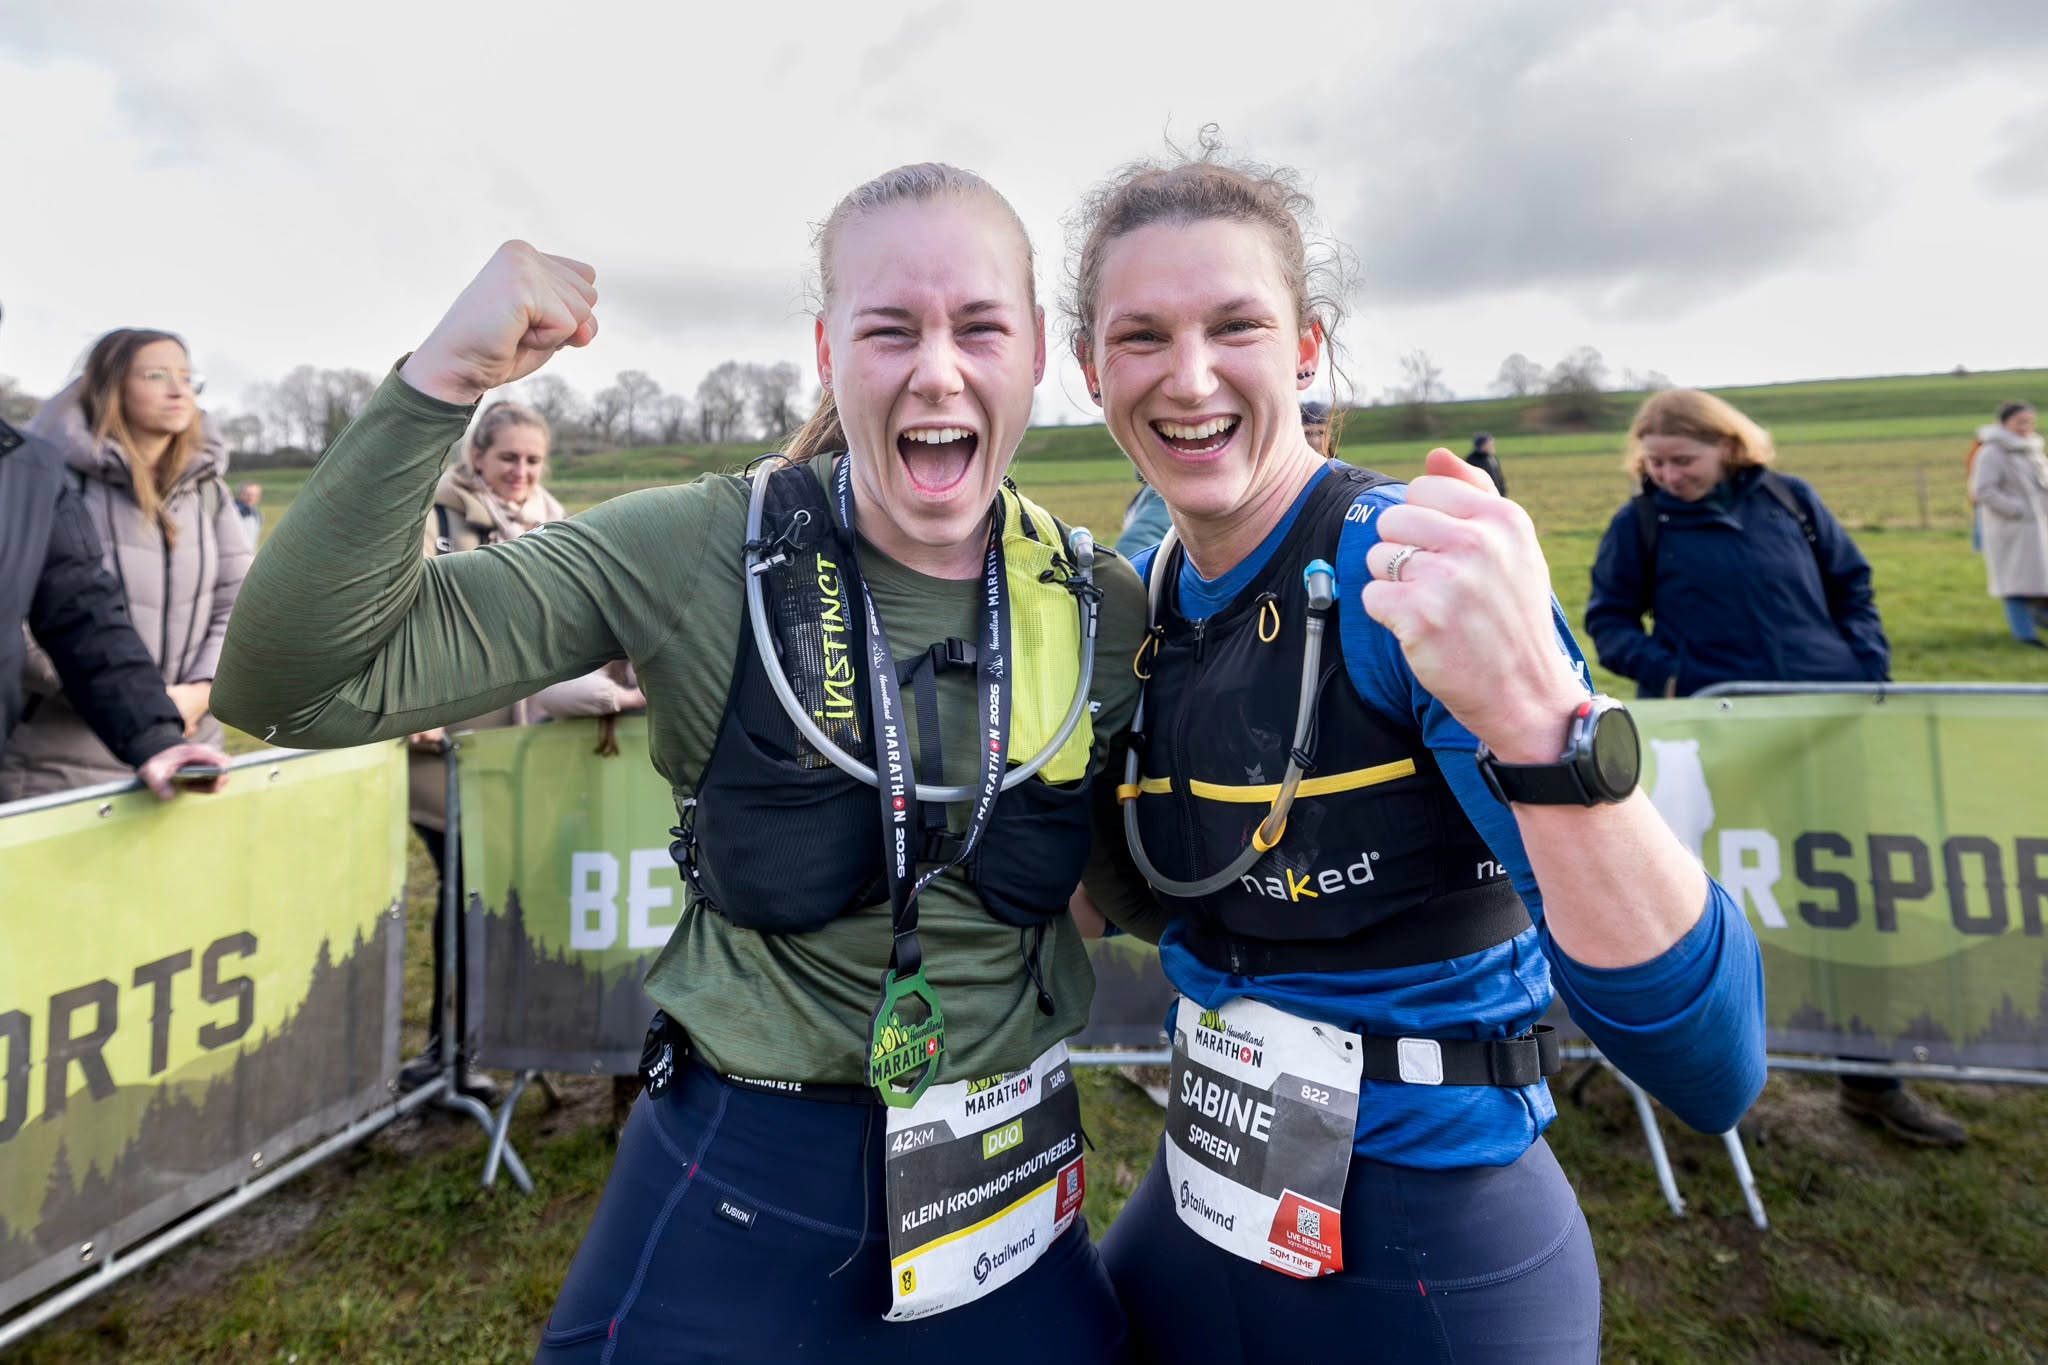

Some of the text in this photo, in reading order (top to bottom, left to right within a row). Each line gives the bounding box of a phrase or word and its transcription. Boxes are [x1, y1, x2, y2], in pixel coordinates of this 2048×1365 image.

[977, 728, 1001, 821] MARATHON
[989, 683, 1000, 726] 2026
[878, 674, 906, 878] Heuvelland MARATHON 2026
[1195, 1028, 1263, 1068] MARATHON
[1226, 1024, 1265, 1048] Heuvelland
[872, 1031, 944, 1084] MARATHON
[965, 1073, 1033, 1117] MARATHON
[1180, 1069, 1277, 1143] SABINE
[1300, 1084, 1330, 1106] 822
[891, 1127, 935, 1153] 42KM
[987, 1128, 1019, 1154] DUO
[1188, 1123, 1241, 1166] SPREEN
[901, 1132, 1077, 1233] KLEIN KROMHOF HOUTVEZELS
[721, 1202, 750, 1223] FUSION
[1189, 1192, 1236, 1232] tailwind
[991, 1231, 1036, 1269] tailwind
[1269, 1247, 1290, 1261] SQM
[1291, 1255, 1313, 1270] TIME
[1286, 1230, 1332, 1254] LIVE RESULTS
